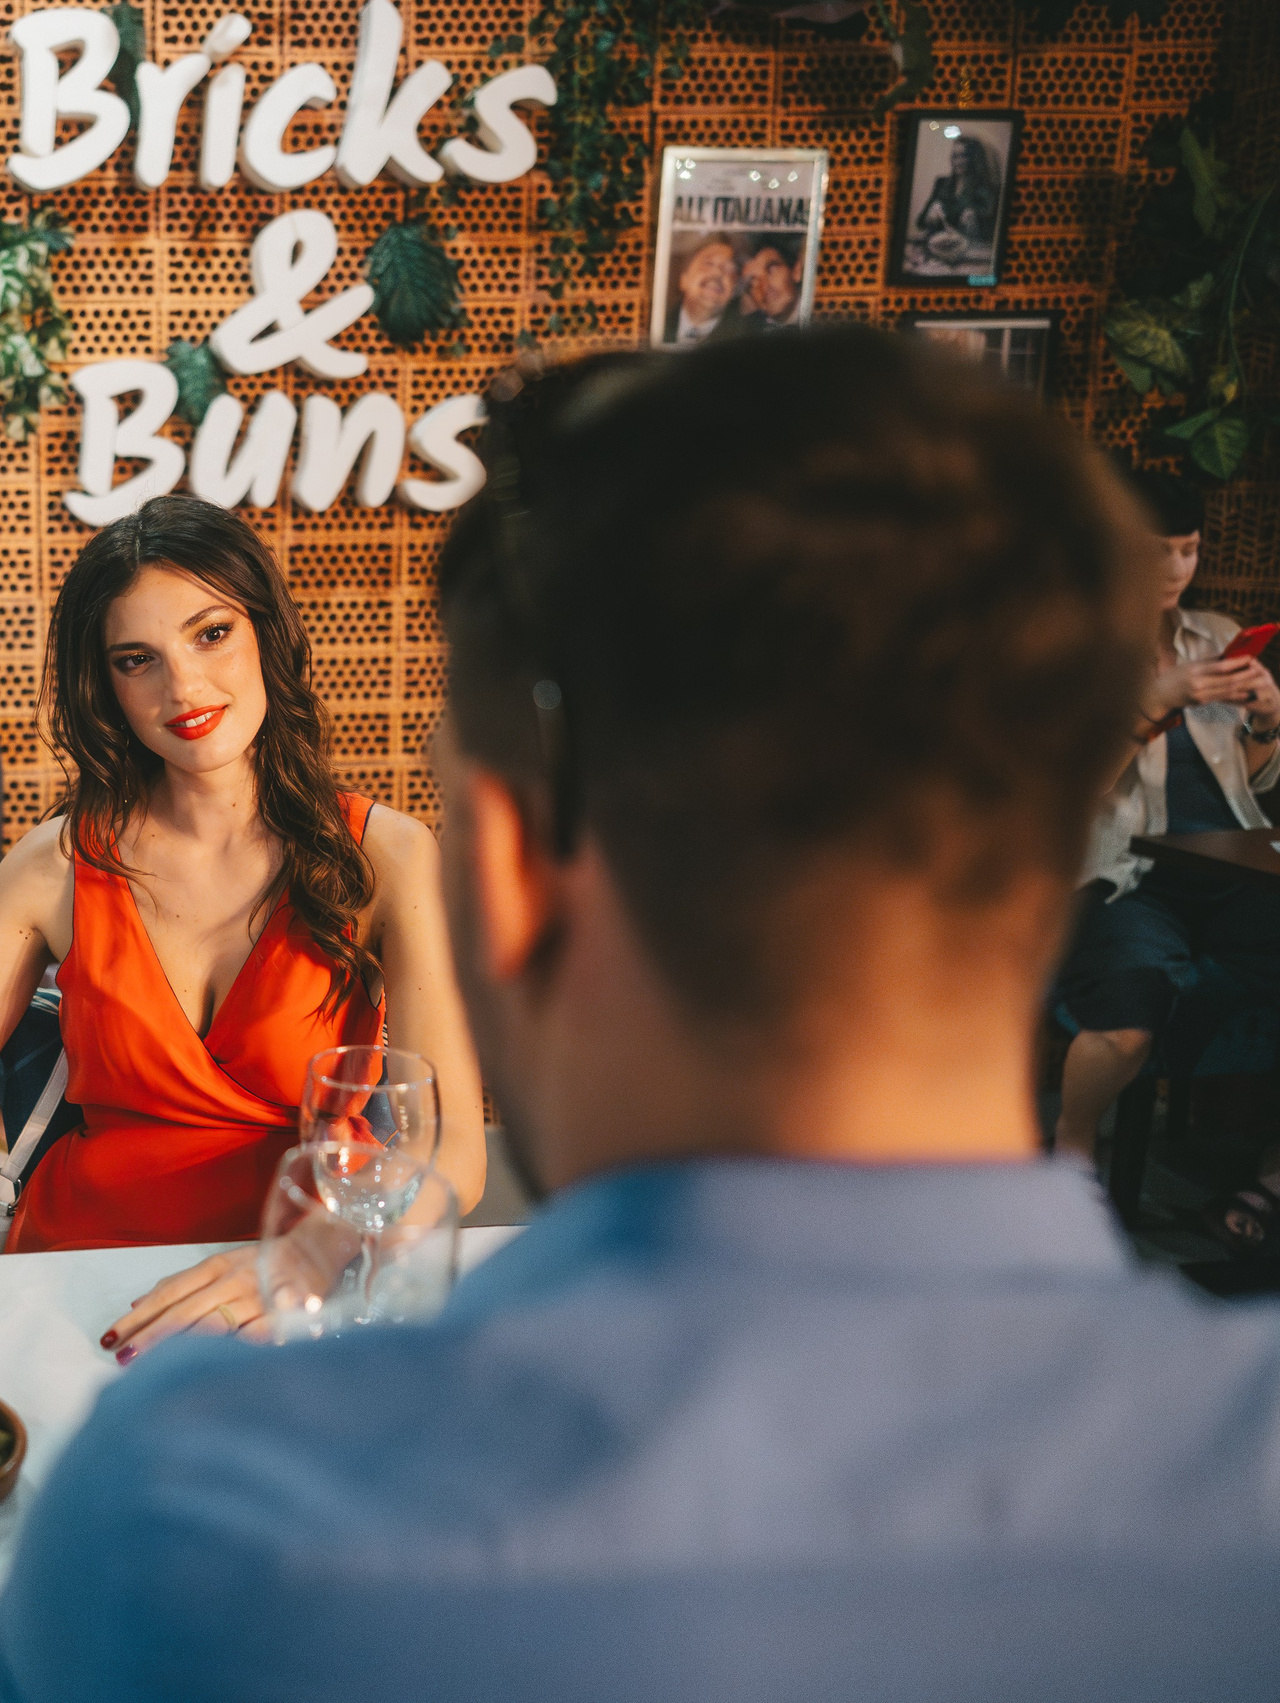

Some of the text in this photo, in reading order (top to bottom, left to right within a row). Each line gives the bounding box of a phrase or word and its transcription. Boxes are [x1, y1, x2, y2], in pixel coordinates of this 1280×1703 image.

[7, 0, 558, 192] Bricks
[211, 208, 375, 380] &
[64, 358, 488, 527] Buns
